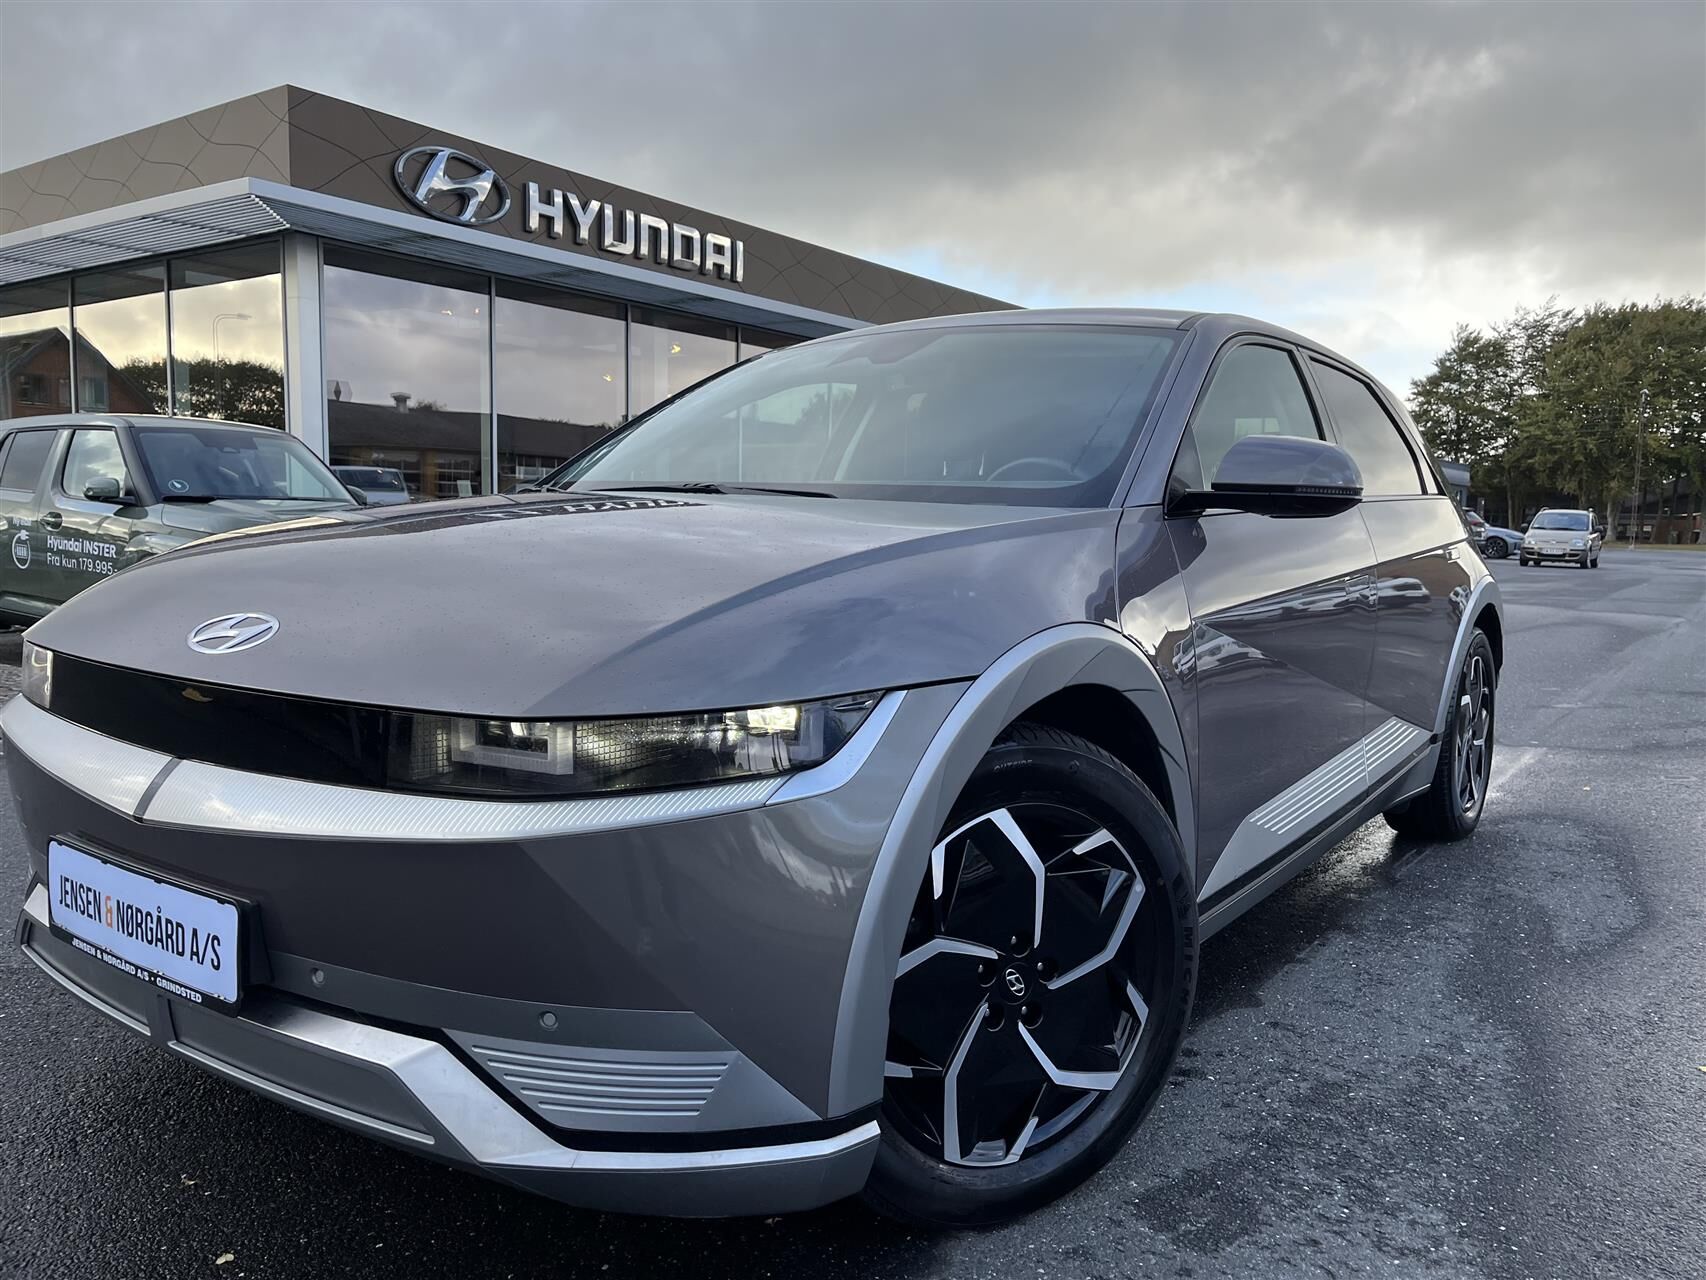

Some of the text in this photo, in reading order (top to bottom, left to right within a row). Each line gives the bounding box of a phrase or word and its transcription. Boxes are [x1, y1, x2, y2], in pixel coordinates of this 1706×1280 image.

[526, 181, 744, 283] HYUNDAI
[47, 535, 116, 558] Hyundai INSTER
[47, 553, 60, 566] Fra
[62, 555, 77, 569] kun
[59, 874, 221, 971] JENSEN & NØRGÅRD A/S
[72, 938, 96, 957] JENSEN
[96, 949, 103, 960] &
[136, 968, 149, 981] A/S
[156, 977, 202, 1003] GRINDSTED
